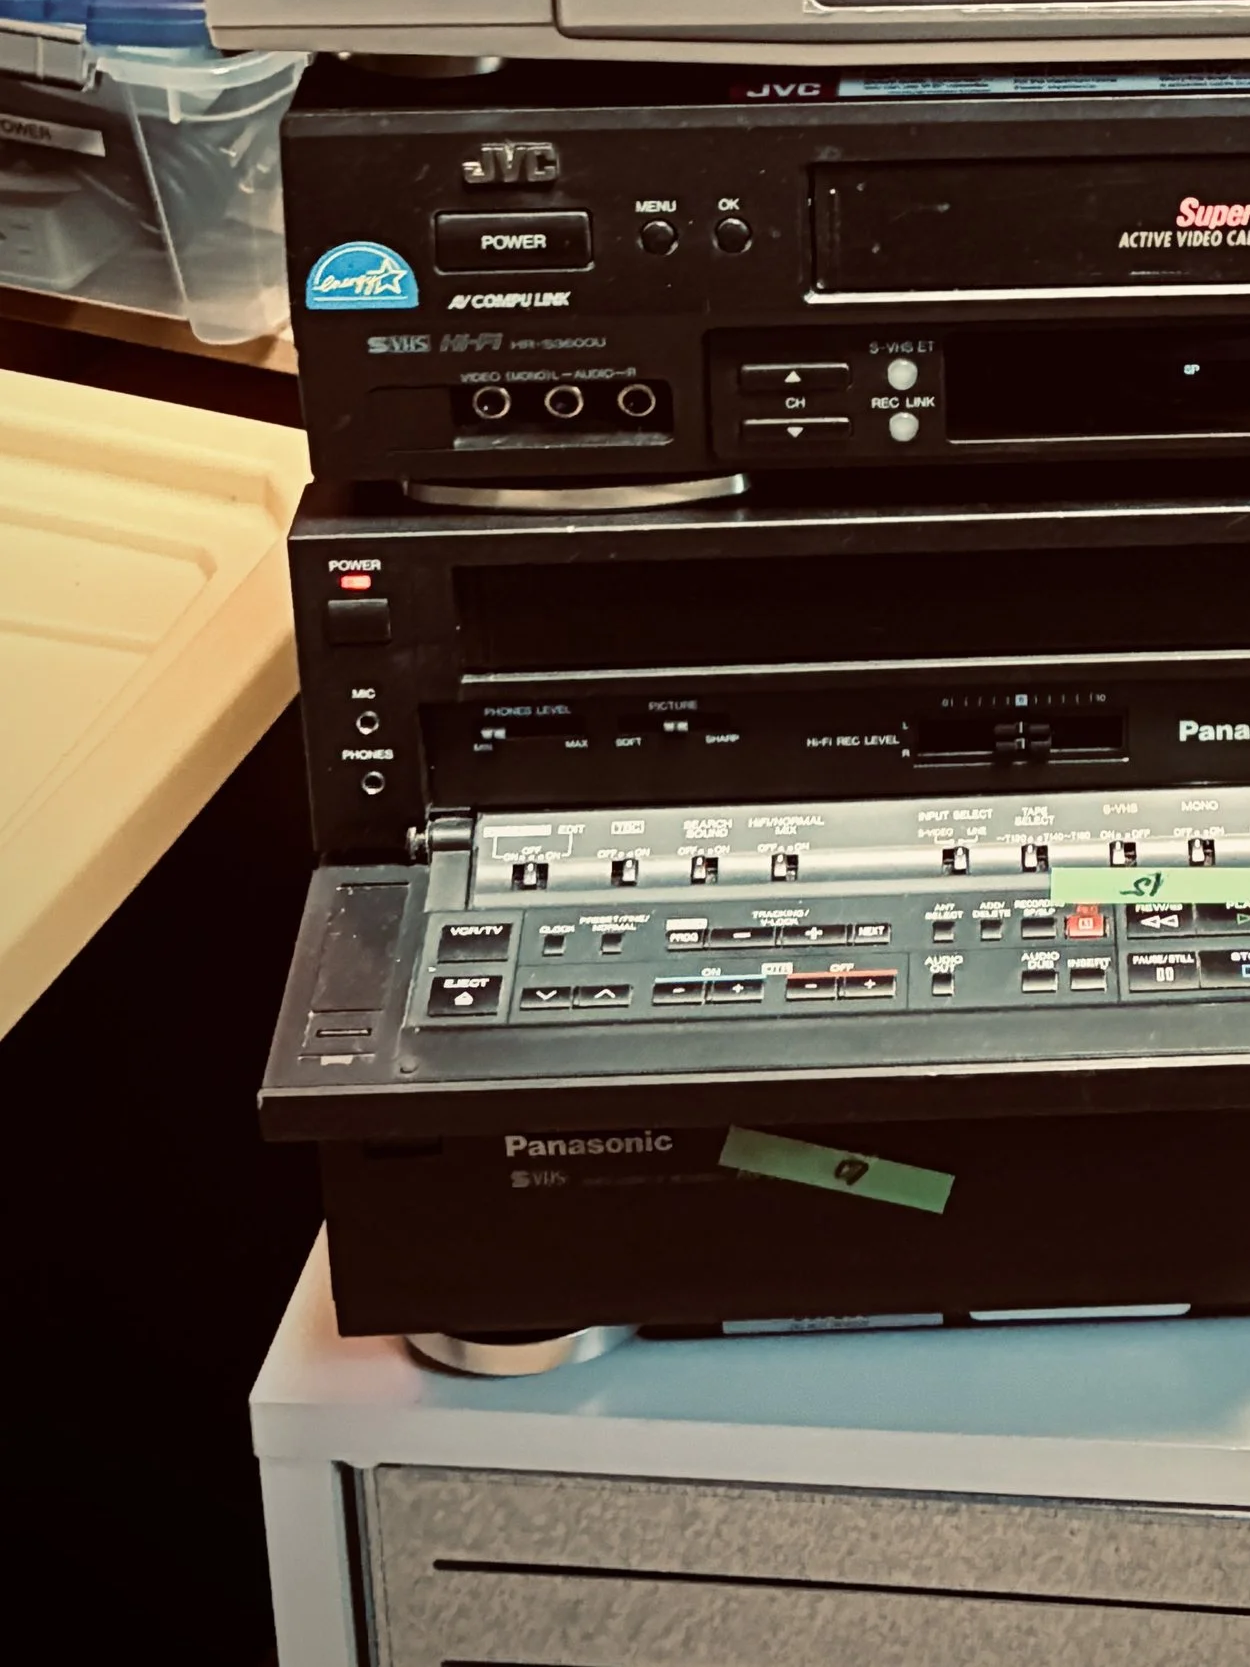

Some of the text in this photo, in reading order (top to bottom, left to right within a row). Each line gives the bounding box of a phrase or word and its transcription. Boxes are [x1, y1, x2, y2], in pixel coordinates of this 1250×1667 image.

[745, 82, 822, 97] JVC
[461, 141, 560, 184] JVC
[635, 200, 677, 214] MENU
[718, 197, 740, 211] OK
[480, 234, 547, 250] POWER
[1118, 231, 1173, 249] ACTIVE
[1176, 229, 1223, 248] VIDEO
[471, 291, 530, 310] COMPU
[533, 290, 571, 308] LINK
[460, 371, 501, 383] VIDEO
[785, 397, 806, 409] CH
[871, 396, 936, 409] REC LINK
[328, 559, 381, 572] POWER
[352, 688, 376, 700] MIC
[648, 699, 698, 711] PICTURE
[342, 748, 394, 761] PHONES
[1181, 800, 1219, 811] MONO
[504, 1131, 673, 1158] Panasonic
